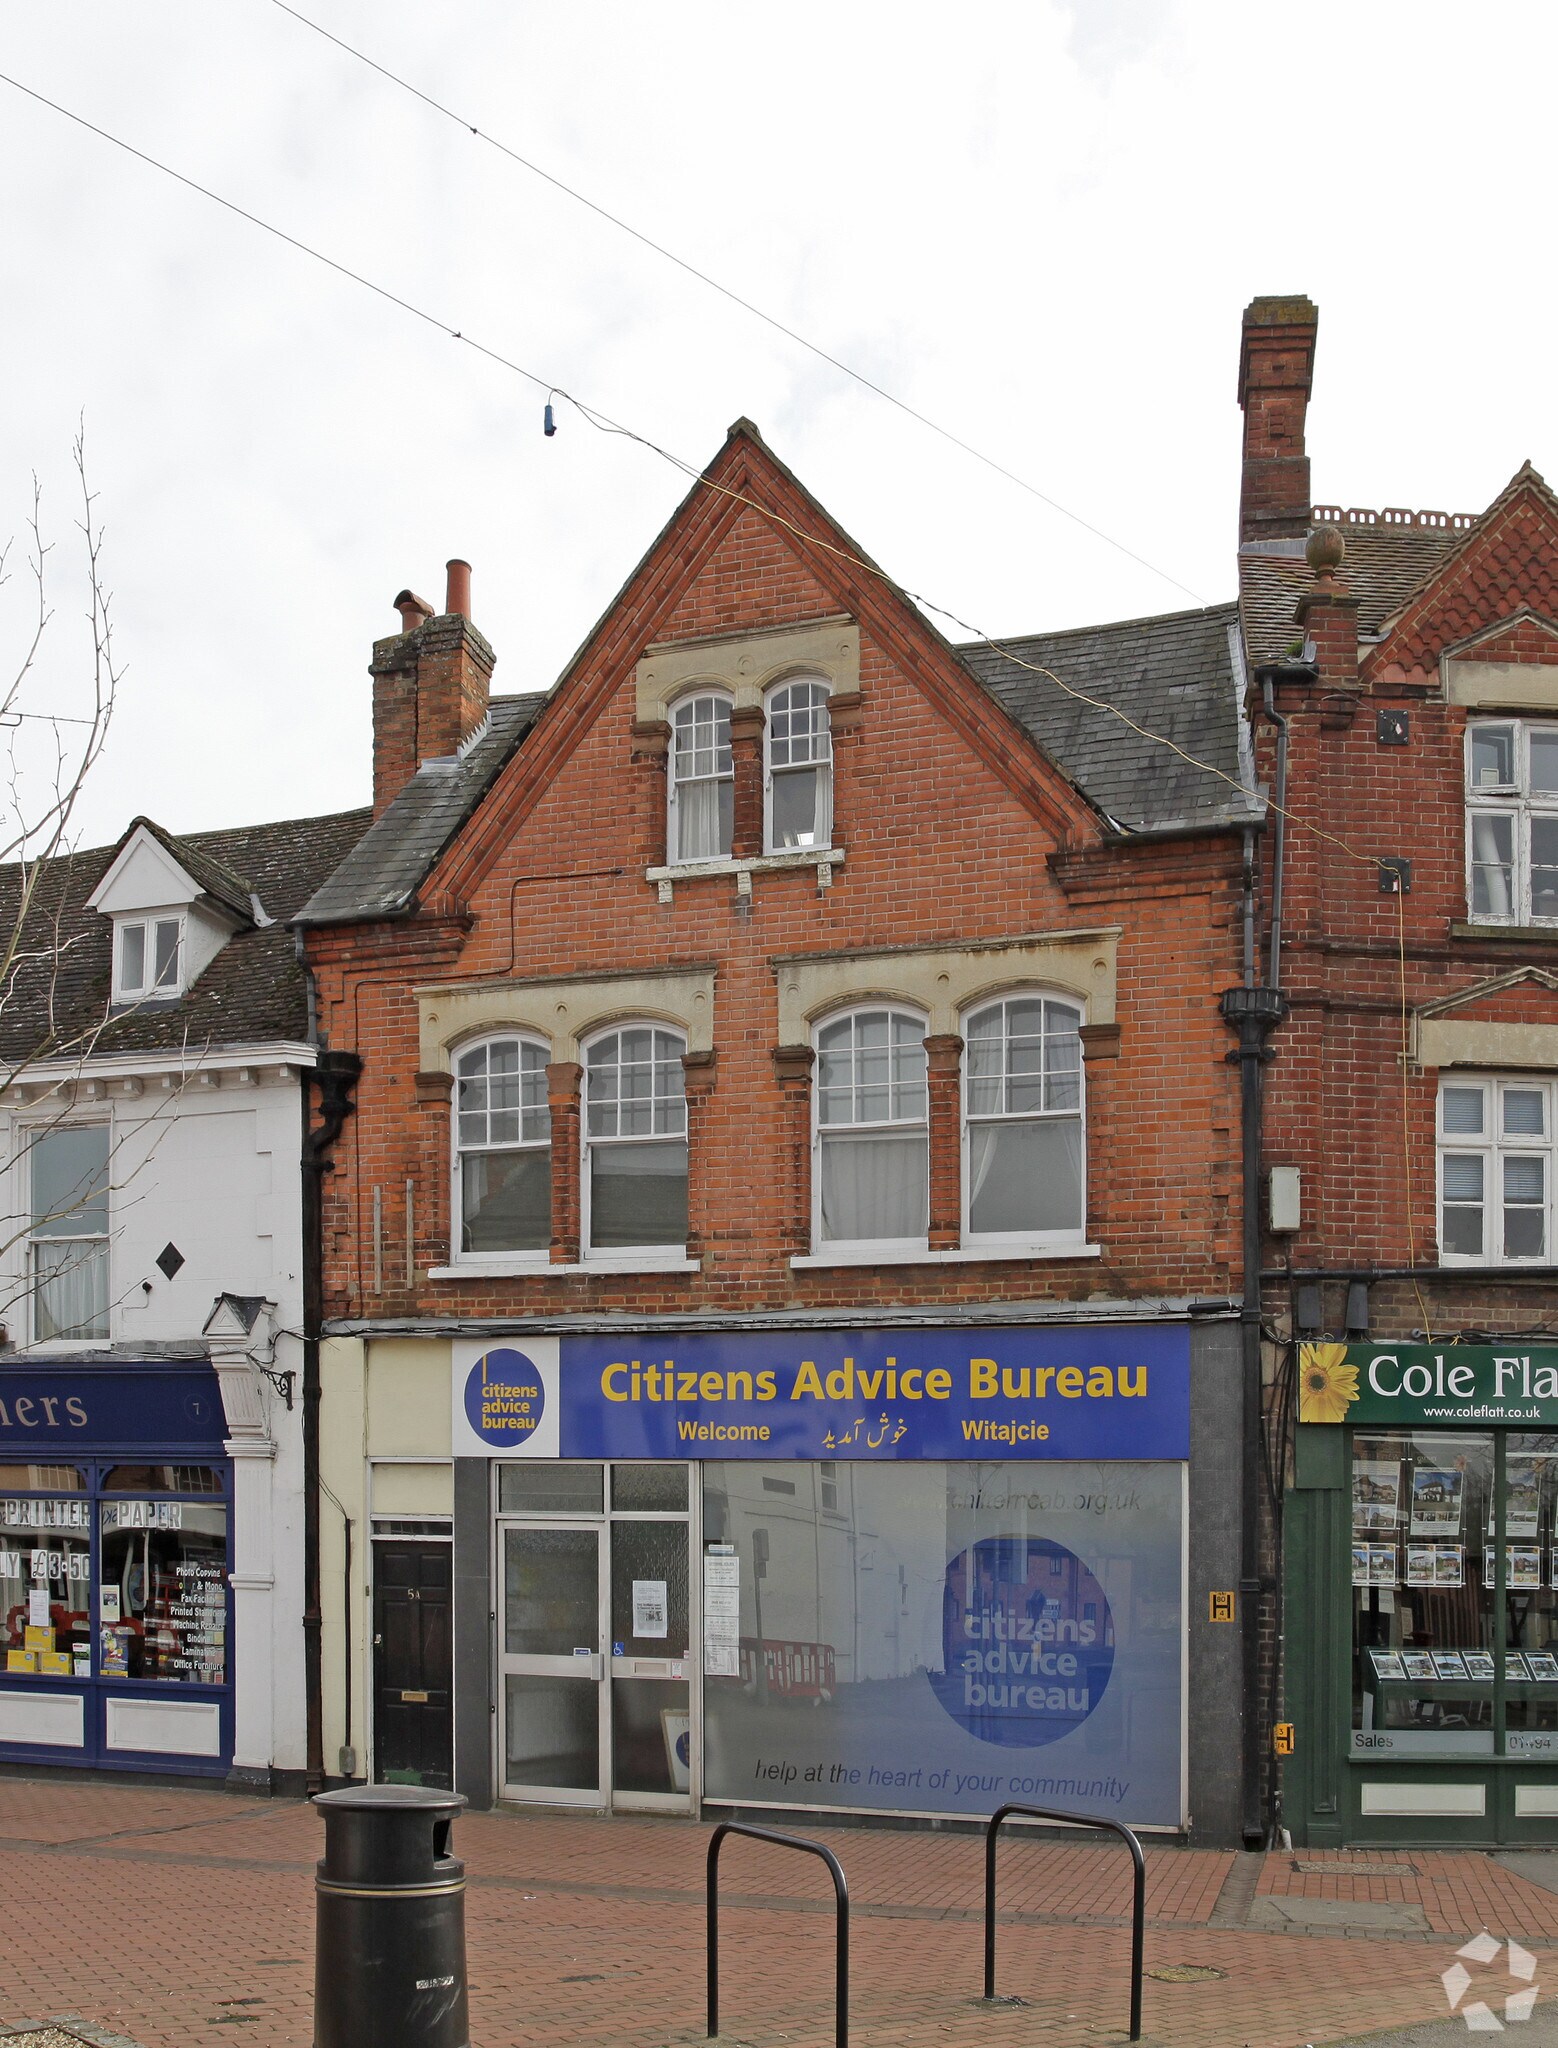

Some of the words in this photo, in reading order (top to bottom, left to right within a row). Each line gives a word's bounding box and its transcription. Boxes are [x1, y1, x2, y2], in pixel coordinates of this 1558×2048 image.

[601, 1360, 777, 1402] Citizens
[790, 1357, 951, 1401] Advice
[970, 1358, 1147, 1398] Bureau
[1368, 1354, 1476, 1398] Cole
[481, 1382, 538, 1398] citizens
[192, 1402, 200, 1416] 7
[481, 1398, 531, 1414] advice
[1423, 1404, 1541, 1419] www.coleflatt.co.uk
[481, 1413, 536, 1429] bureau
[677, 1421, 771, 1441] Welcome
[961, 1419, 1050, 1446] Witajcie
[7, 1500, 90, 1526] PRINTER
[118, 1500, 181, 1528] PAPER
[176, 1566, 194, 1577] Photo
[195, 1566, 221, 1578] Copying
[204, 1581, 223, 1591] Mono
[181, 1593, 192, 1603] Fax
[170, 1606, 194, 1617] Printed
[172, 1619, 199, 1630] Machine
[963, 1608, 1097, 1643] citizens
[173, 1659, 193, 1669] Office
[193, 1660, 224, 1671] Furniture
[964, 1642, 1078, 1677] advice
[964, 1674, 1089, 1711] bureau
[1355, 1733, 1394, 1748] Sales
[755, 1759, 798, 1785] help
[804, 1762, 823, 1783] at
[830, 1763, 861, 1785] the
[868, 1765, 923, 1788] heart
[928, 1768, 951, 1789] of
[953, 1774, 1004, 1796] your
[1009, 1774, 1131, 1802] community
